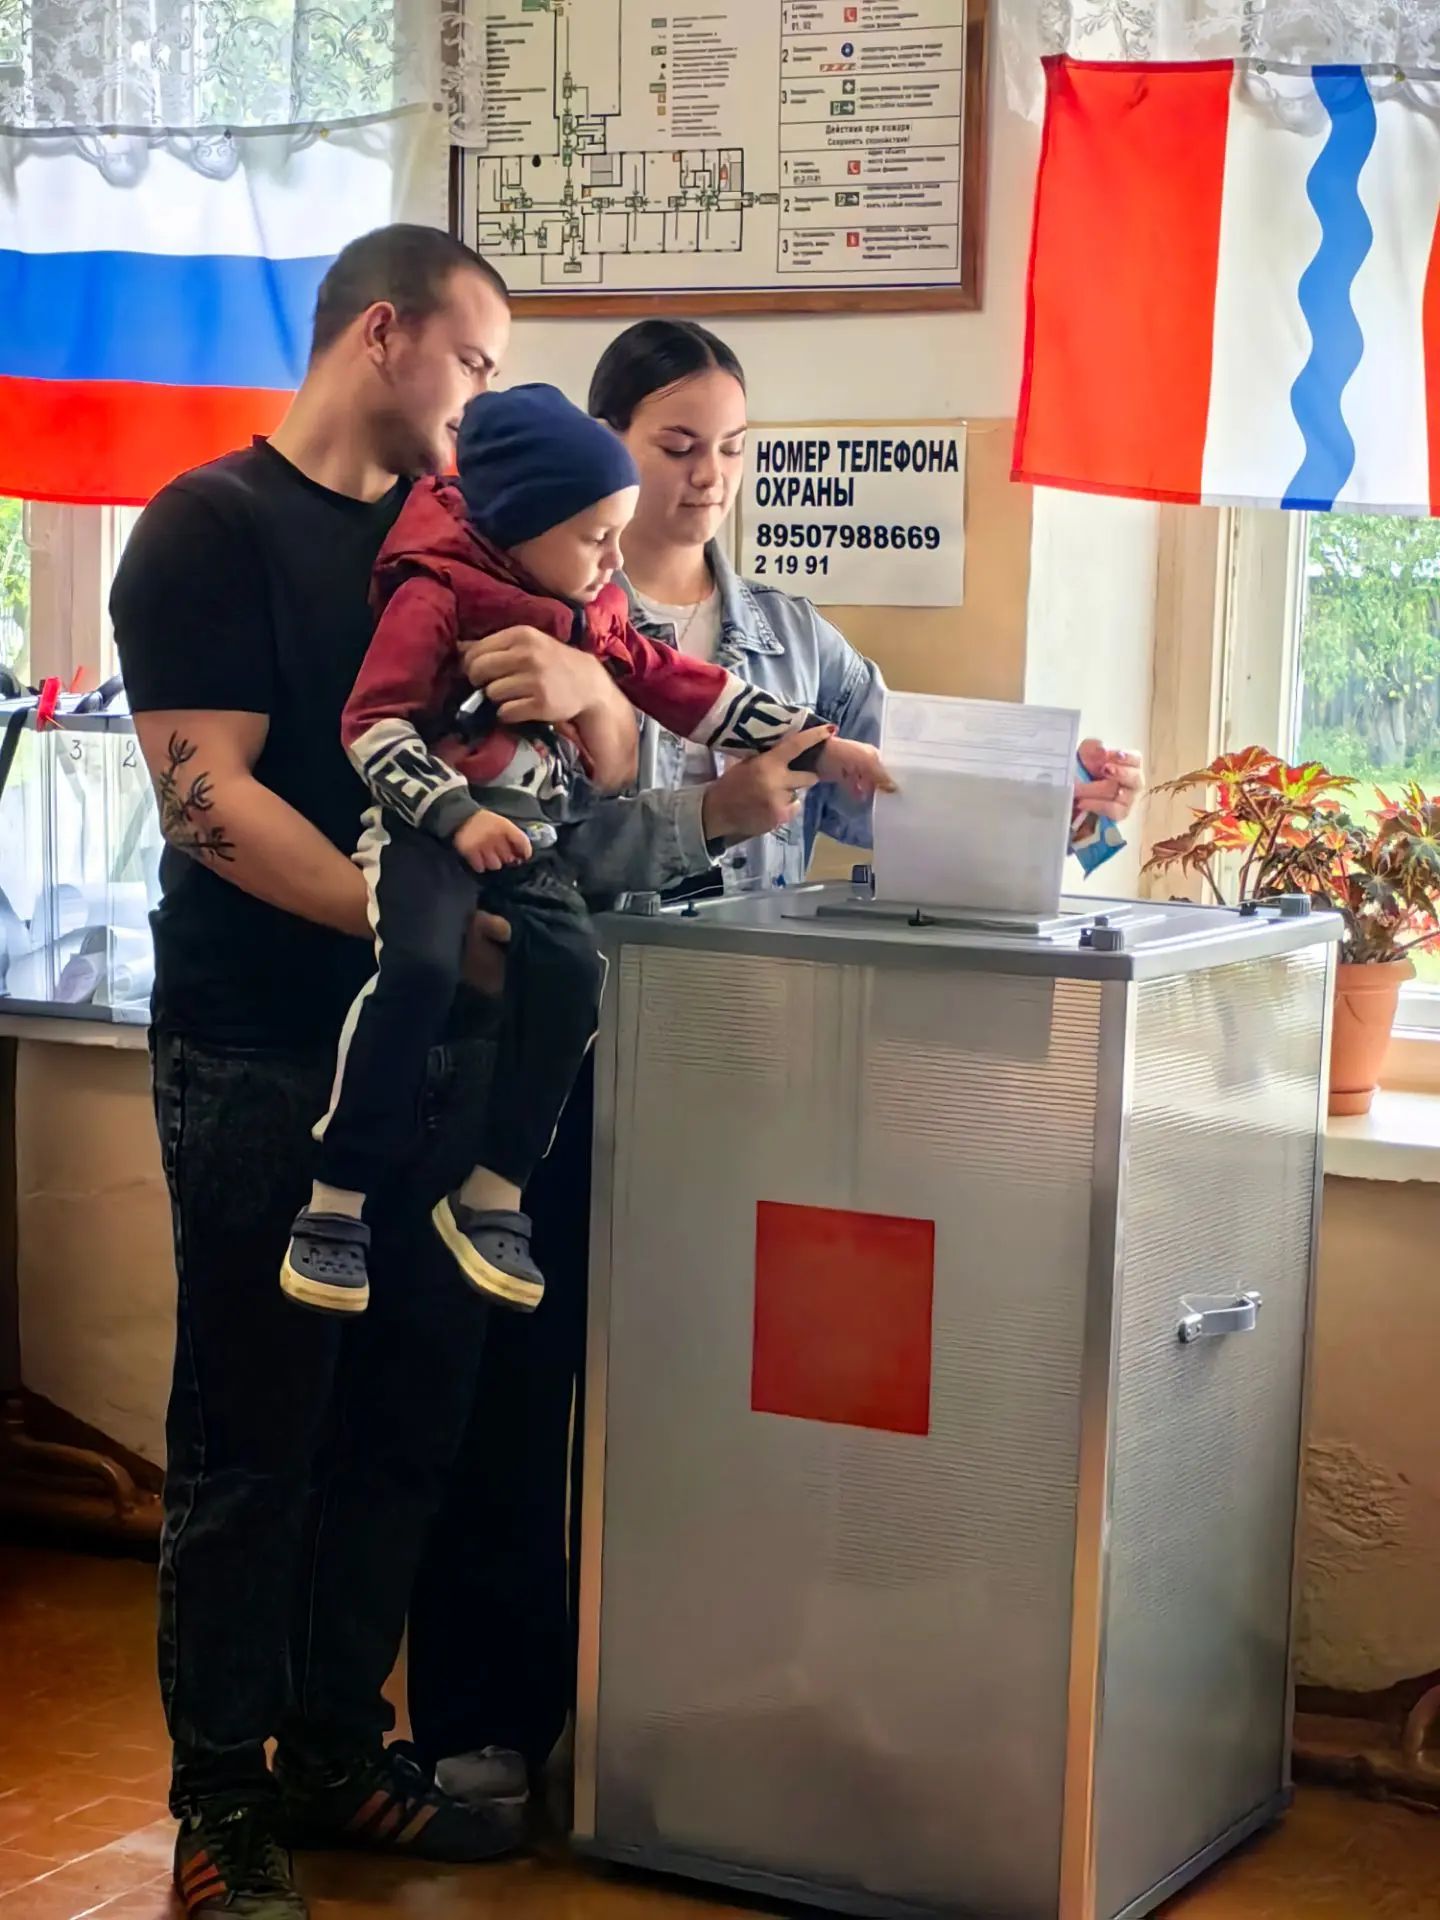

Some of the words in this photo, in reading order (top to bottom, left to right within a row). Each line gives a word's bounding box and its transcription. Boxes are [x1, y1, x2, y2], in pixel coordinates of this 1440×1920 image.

[782, 49, 789, 63] 2
[784, 199, 790, 213] 2
[782, 239, 789, 253] 3
[756, 440, 831, 473] НОМЕР
[837, 439, 959, 473] ТЕЛЕФОНА
[756, 477, 854, 507] ОХРАНЫ
[756, 523, 941, 550] 89507988669
[754, 554, 767, 574] 2
[774, 554, 798, 575] 19
[805, 554, 829, 576] 91
[69, 739, 83, 761] 3
[122, 740, 138, 768] 2
